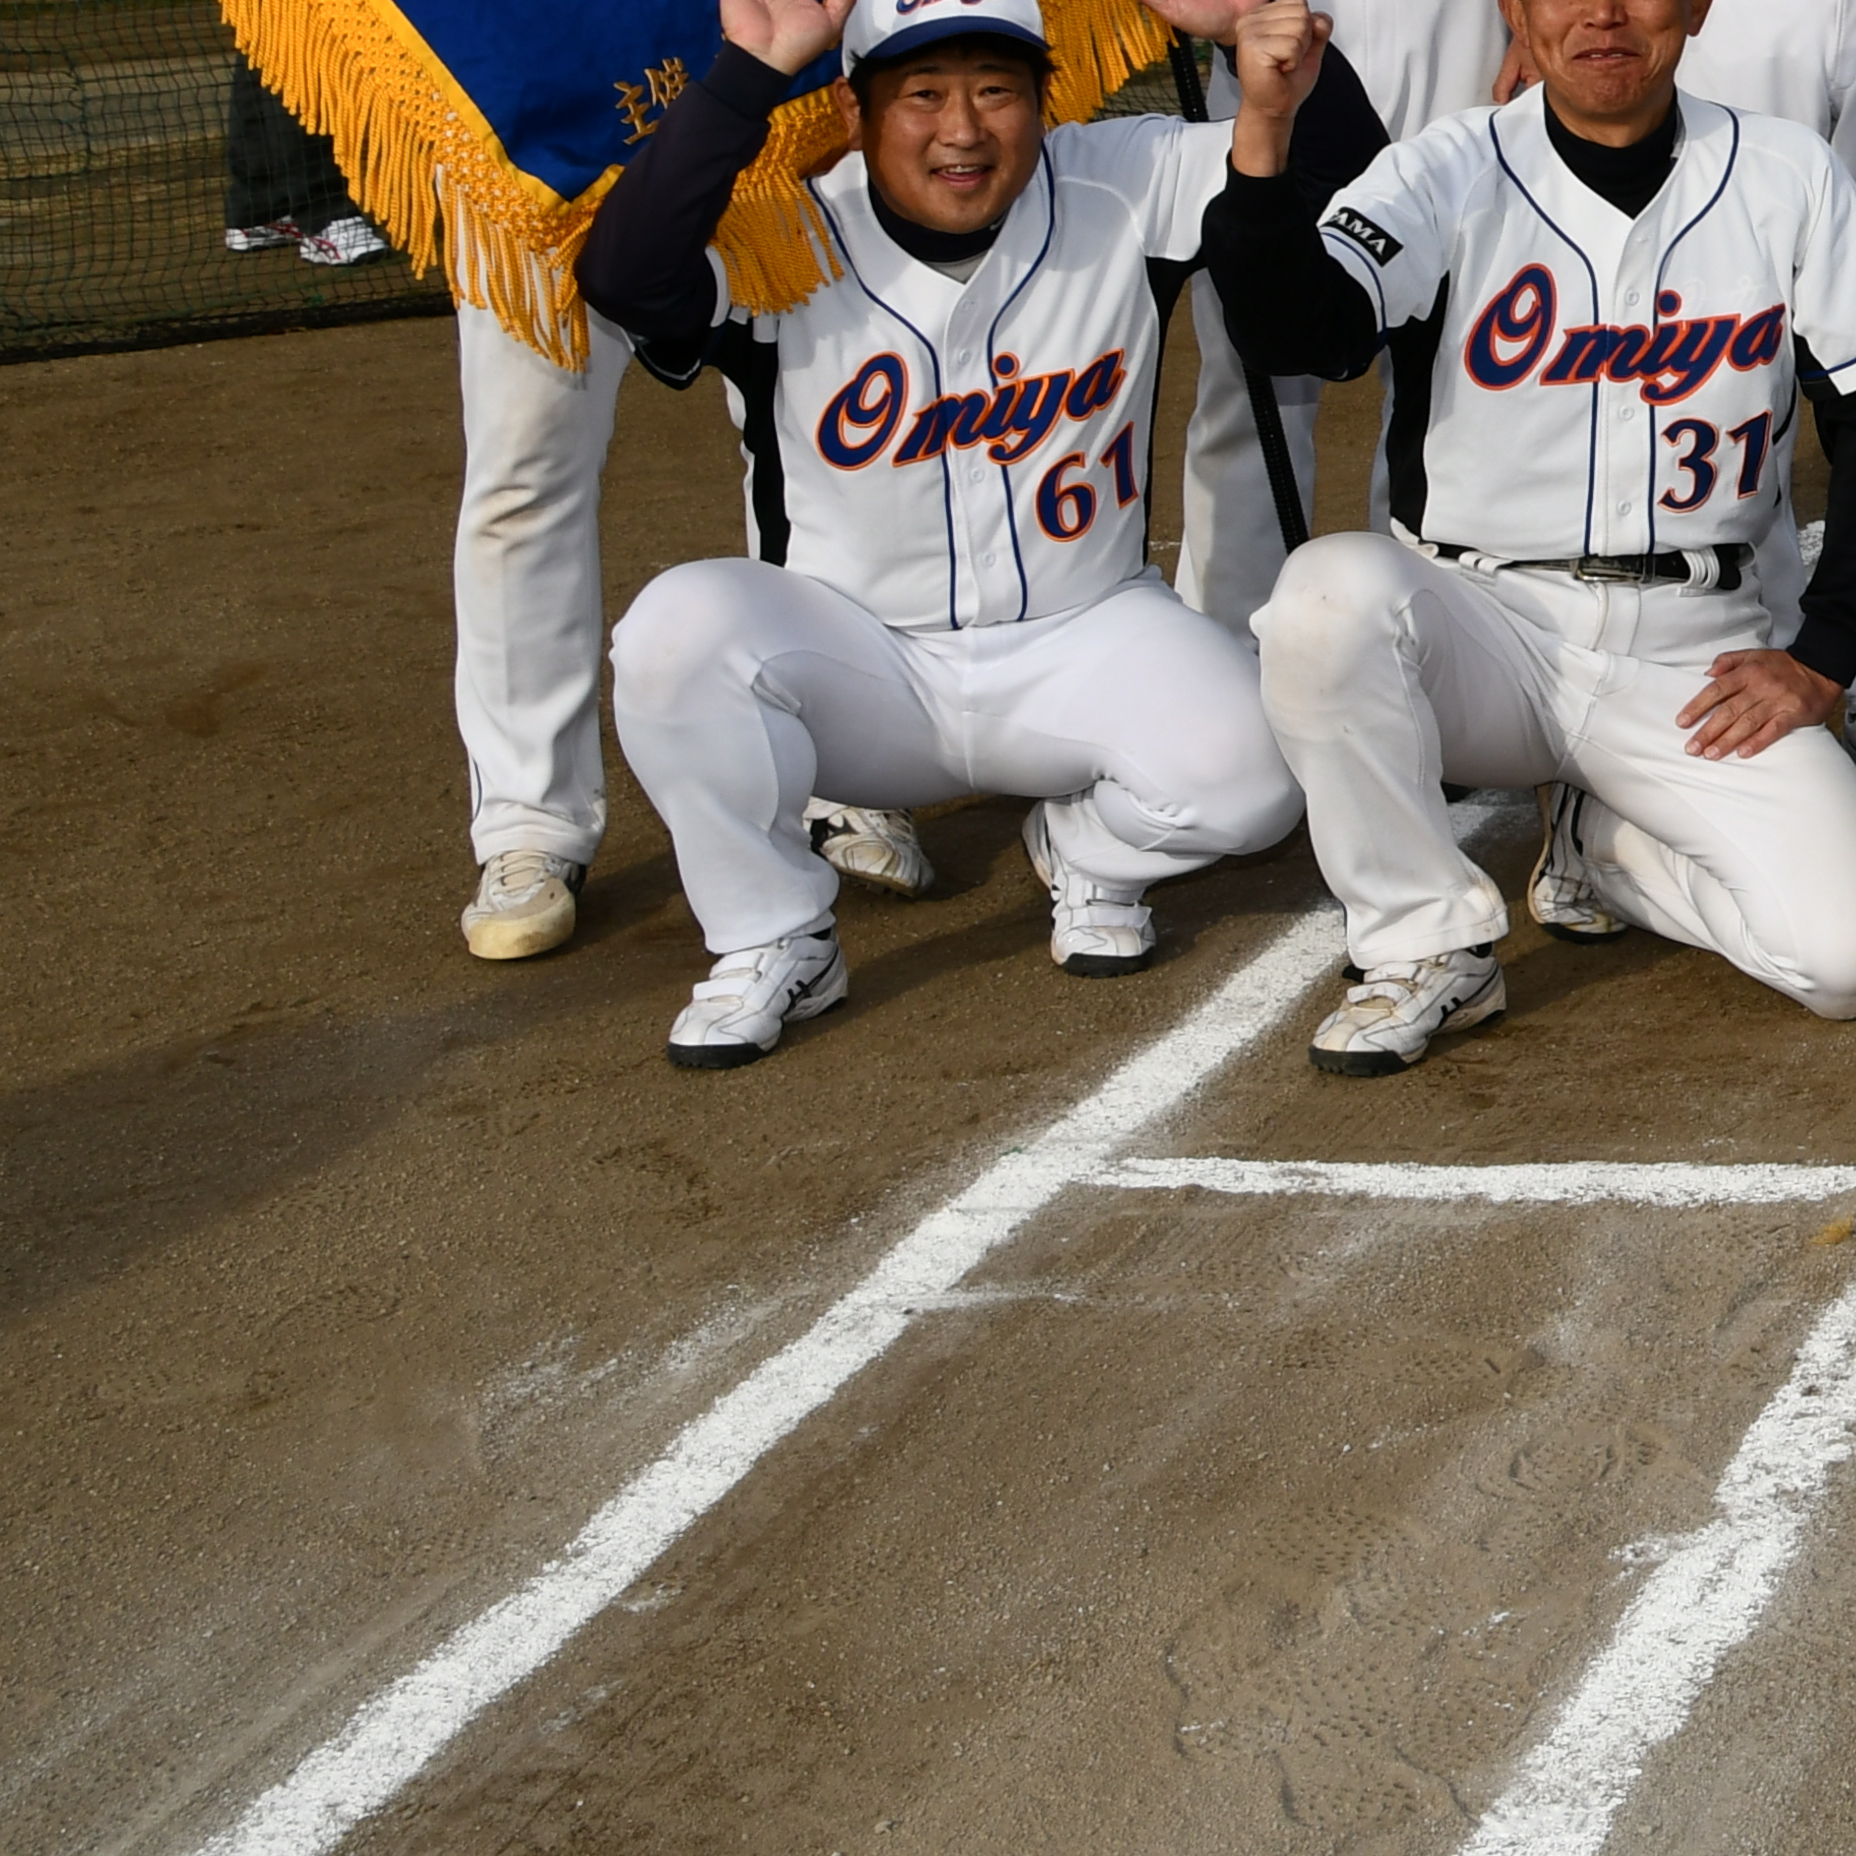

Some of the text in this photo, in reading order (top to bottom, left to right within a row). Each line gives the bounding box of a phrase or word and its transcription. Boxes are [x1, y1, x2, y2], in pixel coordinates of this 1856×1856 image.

[1464, 262, 1787, 407] Omiya
[815, 348, 1127, 471] Omiya
[1657, 410, 1773, 514] 31
[1035, 422, 1139, 542] 61
